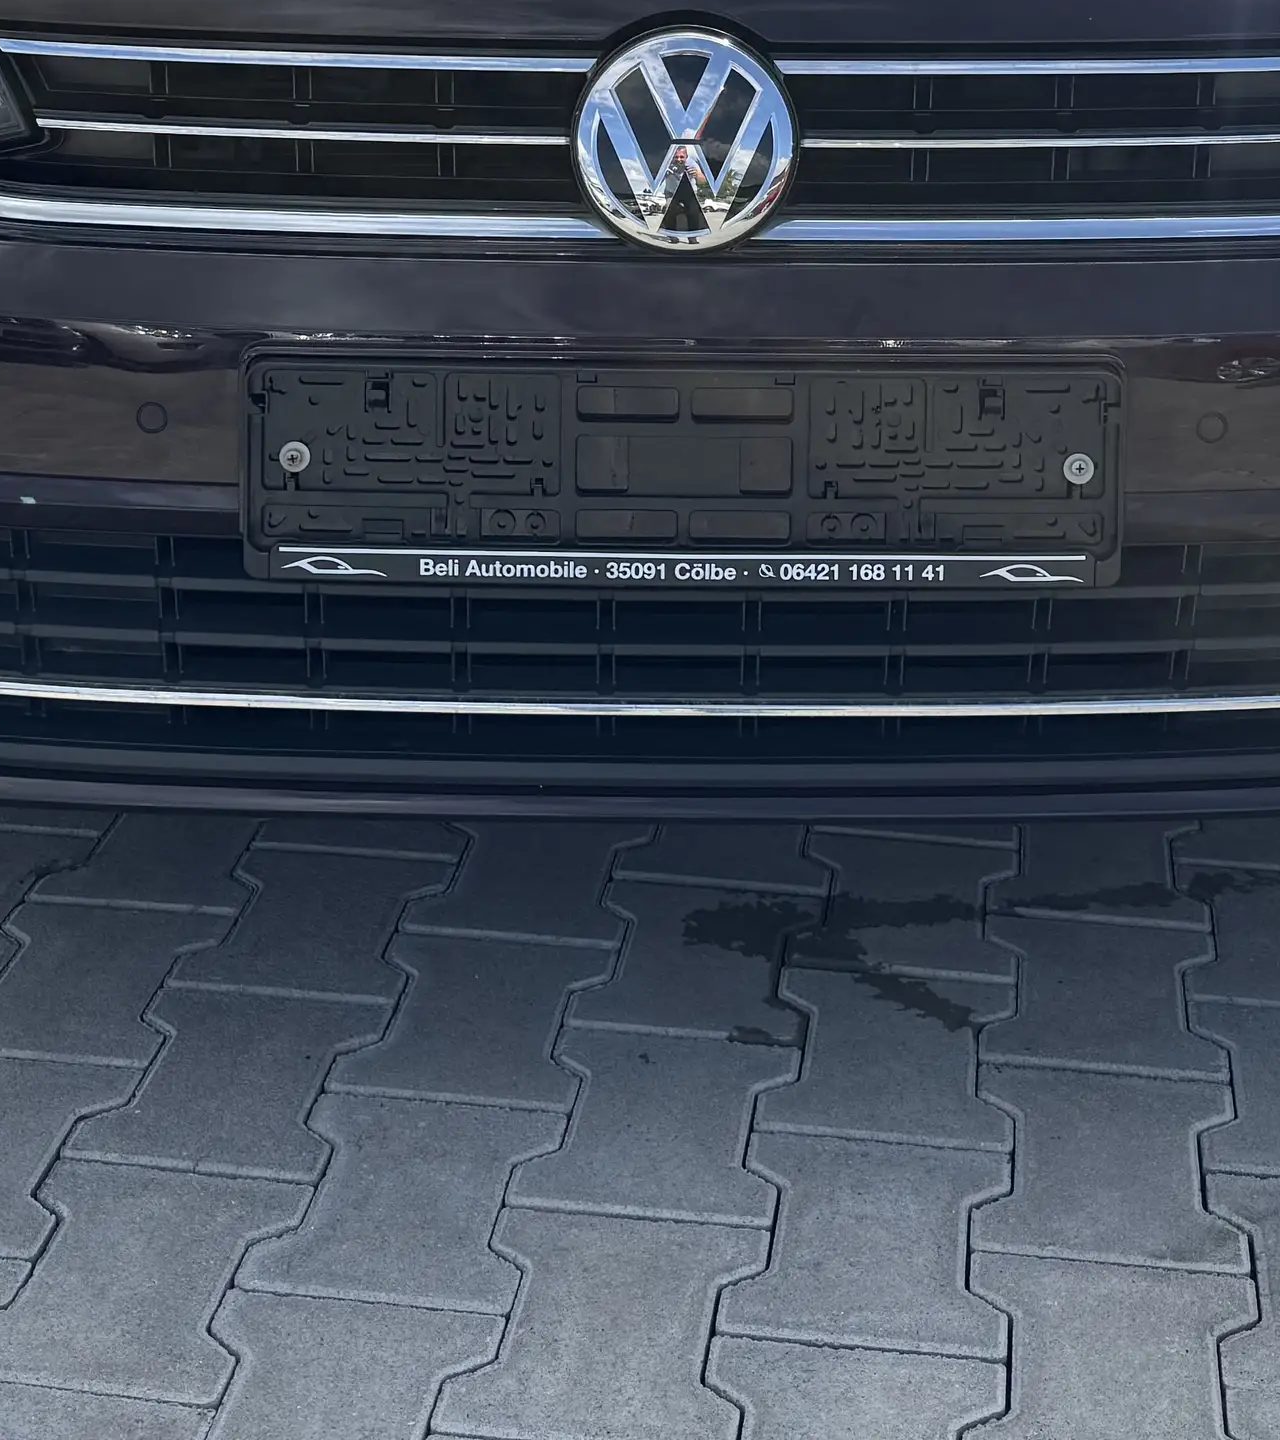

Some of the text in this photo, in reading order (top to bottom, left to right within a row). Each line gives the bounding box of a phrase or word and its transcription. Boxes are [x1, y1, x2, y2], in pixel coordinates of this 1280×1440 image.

[419, 558, 946, 581] Beli Automobile 35091 Cölbe 06421 168 11 41
